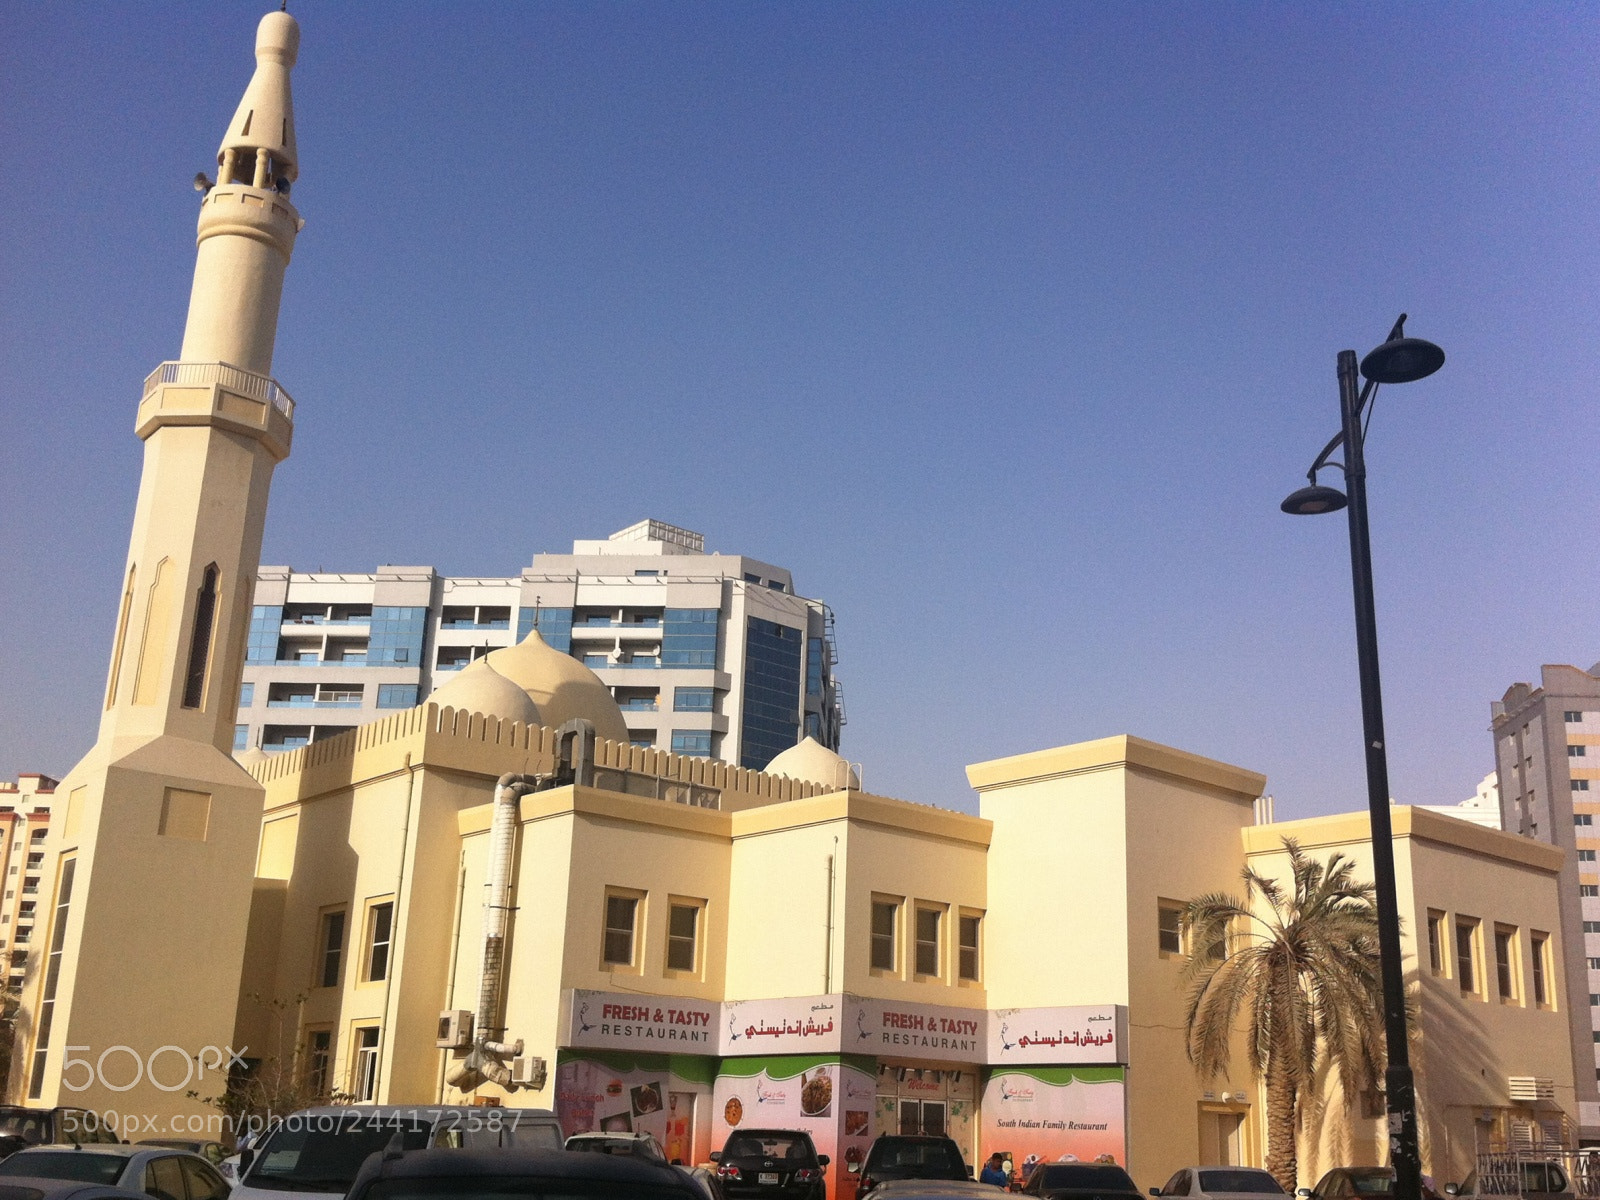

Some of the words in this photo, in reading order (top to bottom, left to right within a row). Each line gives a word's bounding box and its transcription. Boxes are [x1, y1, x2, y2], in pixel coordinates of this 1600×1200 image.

[602, 1004, 649, 1021] FRESH
[653, 1008, 664, 1023] &
[667, 1009, 710, 1026] TASTY
[811, 1003, 834, 1012] مطعم
[802, 1016, 833, 1037] فريش
[882, 1012, 924, 1030] FRESH
[927, 1017, 937, 1032] &
[940, 1018, 978, 1036] TASTY
[1087, 1014, 1112, 1022] مطعم
[601, 1024, 709, 1042] RESTAURANT
[745, 1019, 786, 1039] تيستي
[1080, 1028, 1113, 1047] فريش
[882, 1032, 976, 1051] RESTAURANT
[1018, 1030, 1062, 1048] تيستي
[907, 1078, 940, 1091] Welcome
[997, 1119, 1016, 1128] South
[1018, 1119, 1040, 1129] Indian
[1042, 1120, 1067, 1131] Family
[1068, 1121, 1107, 1131] Restaurant
